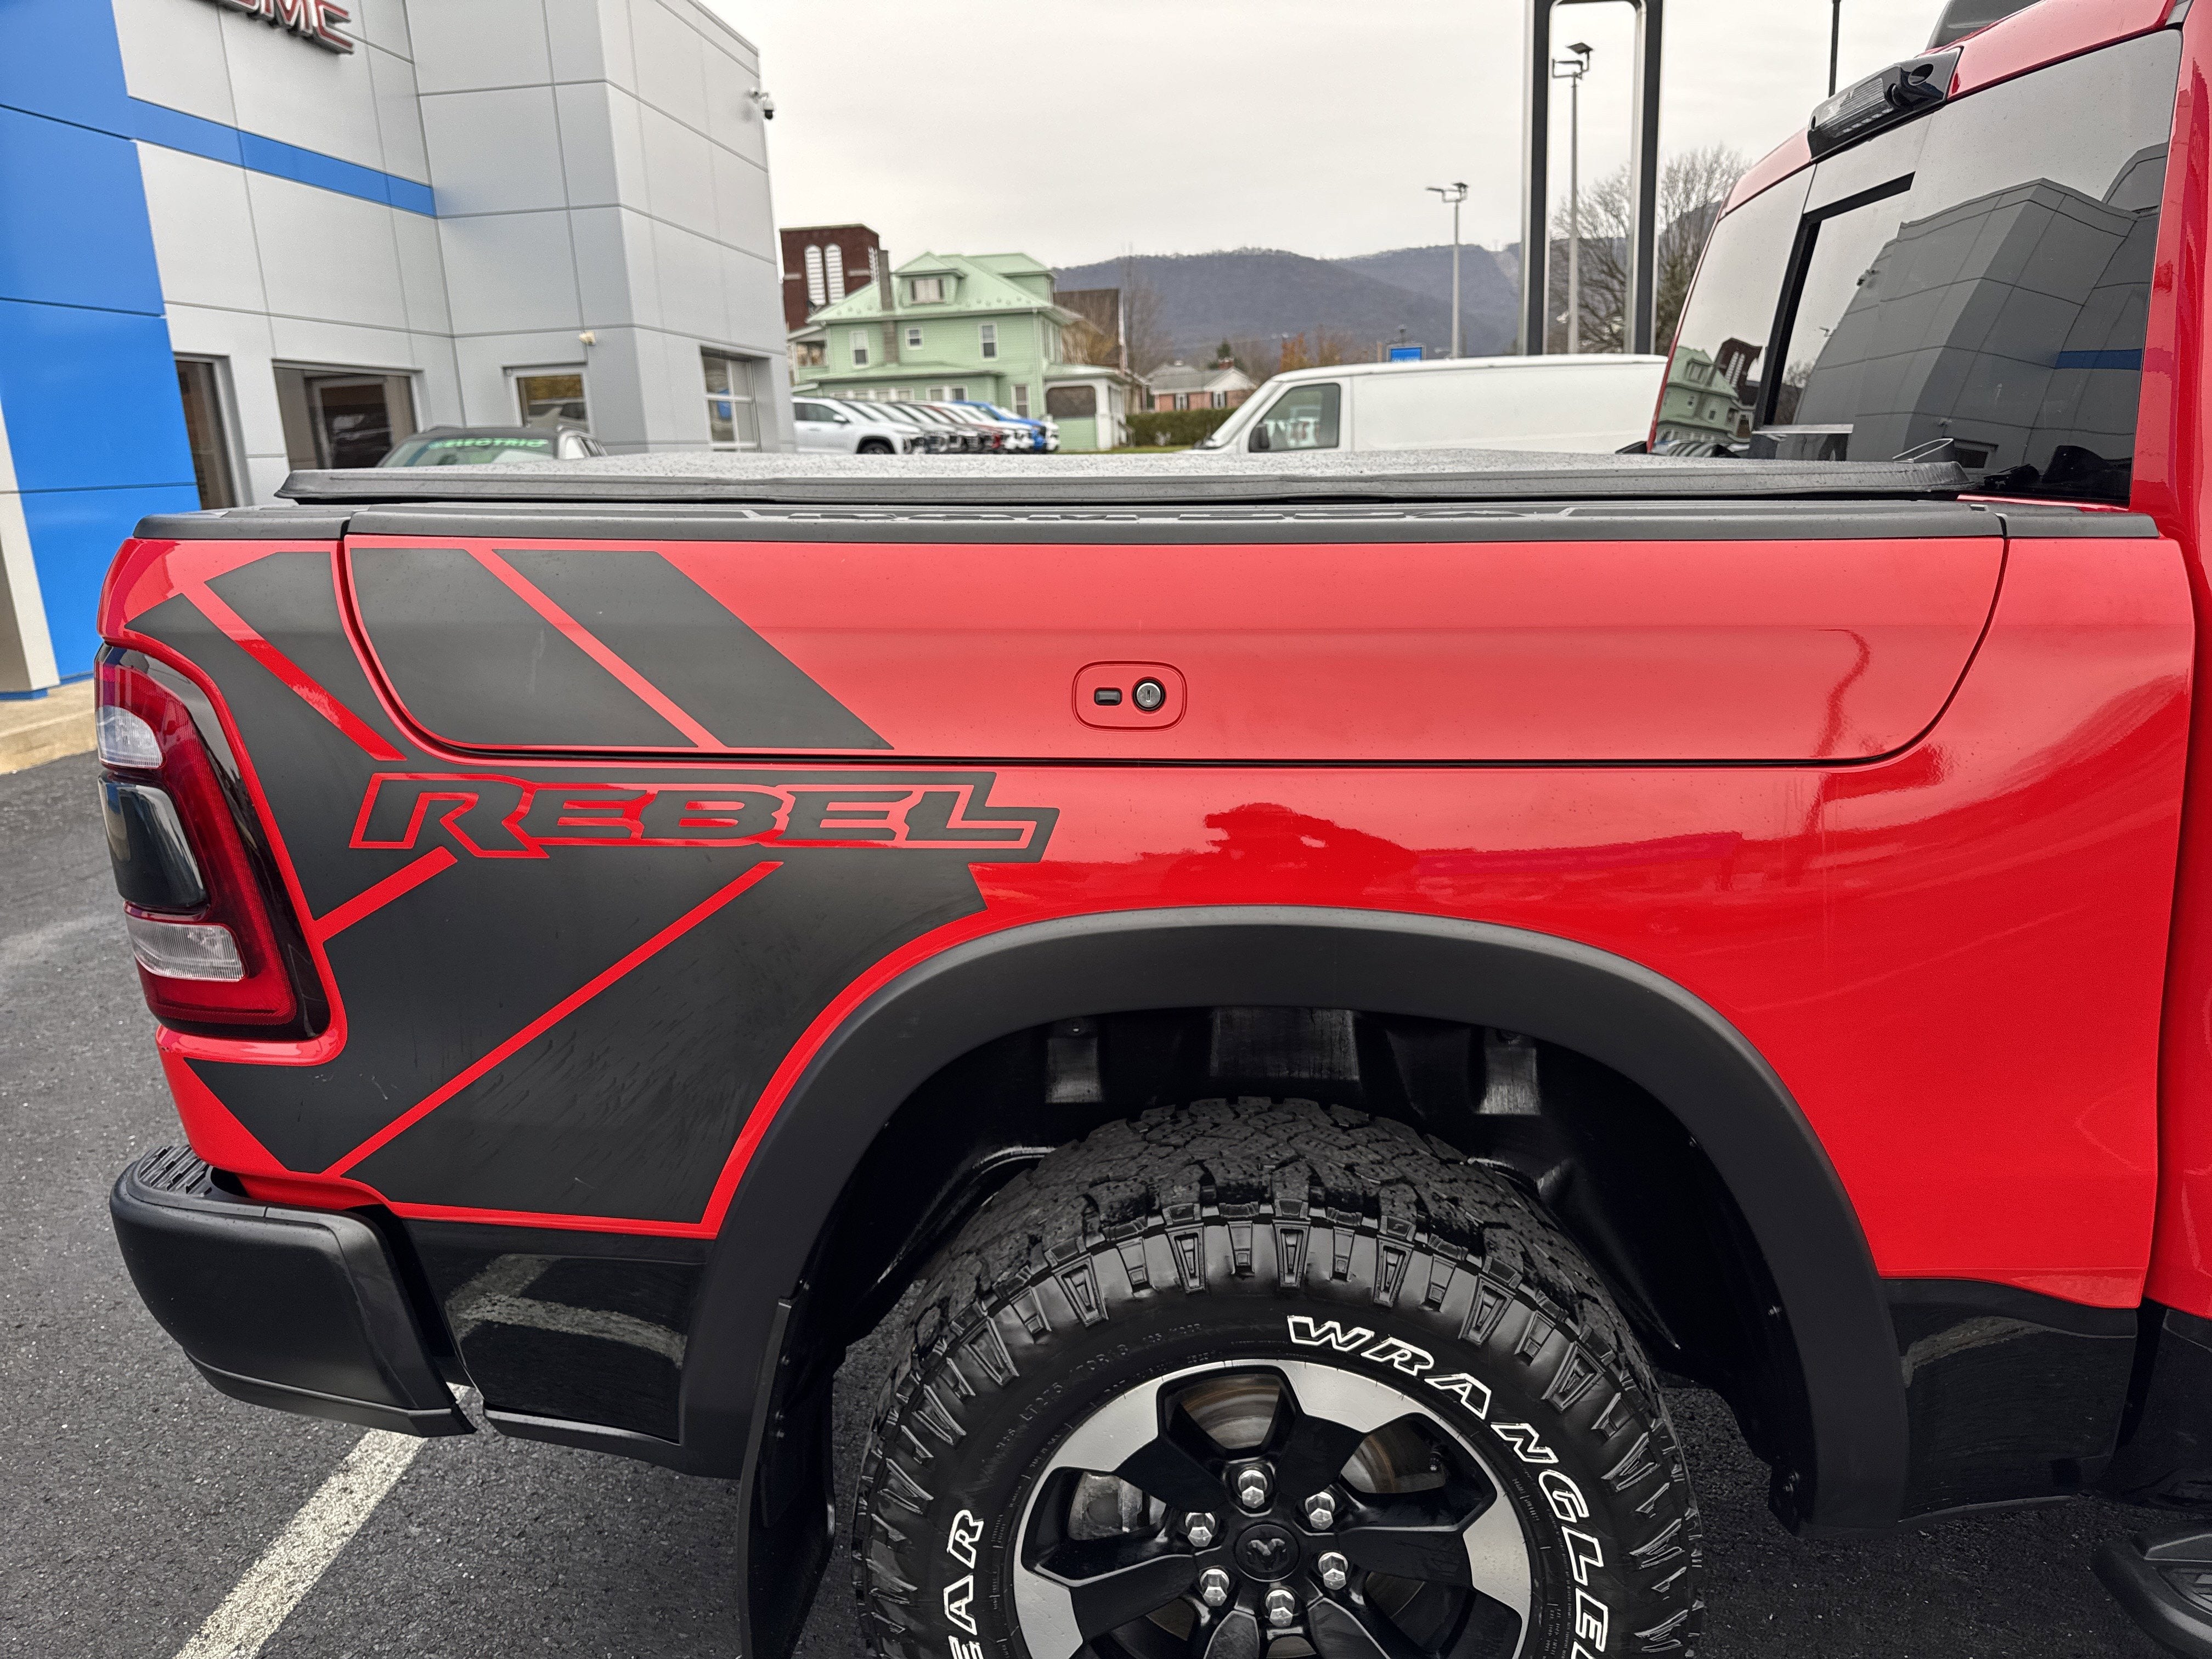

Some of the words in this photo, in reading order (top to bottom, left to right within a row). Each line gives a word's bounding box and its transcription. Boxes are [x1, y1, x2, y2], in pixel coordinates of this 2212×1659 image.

[229, 0, 354, 54] MC
[349, 772, 1037, 859] REBEL
[1287, 1315, 1609, 1659] WRANGLE
